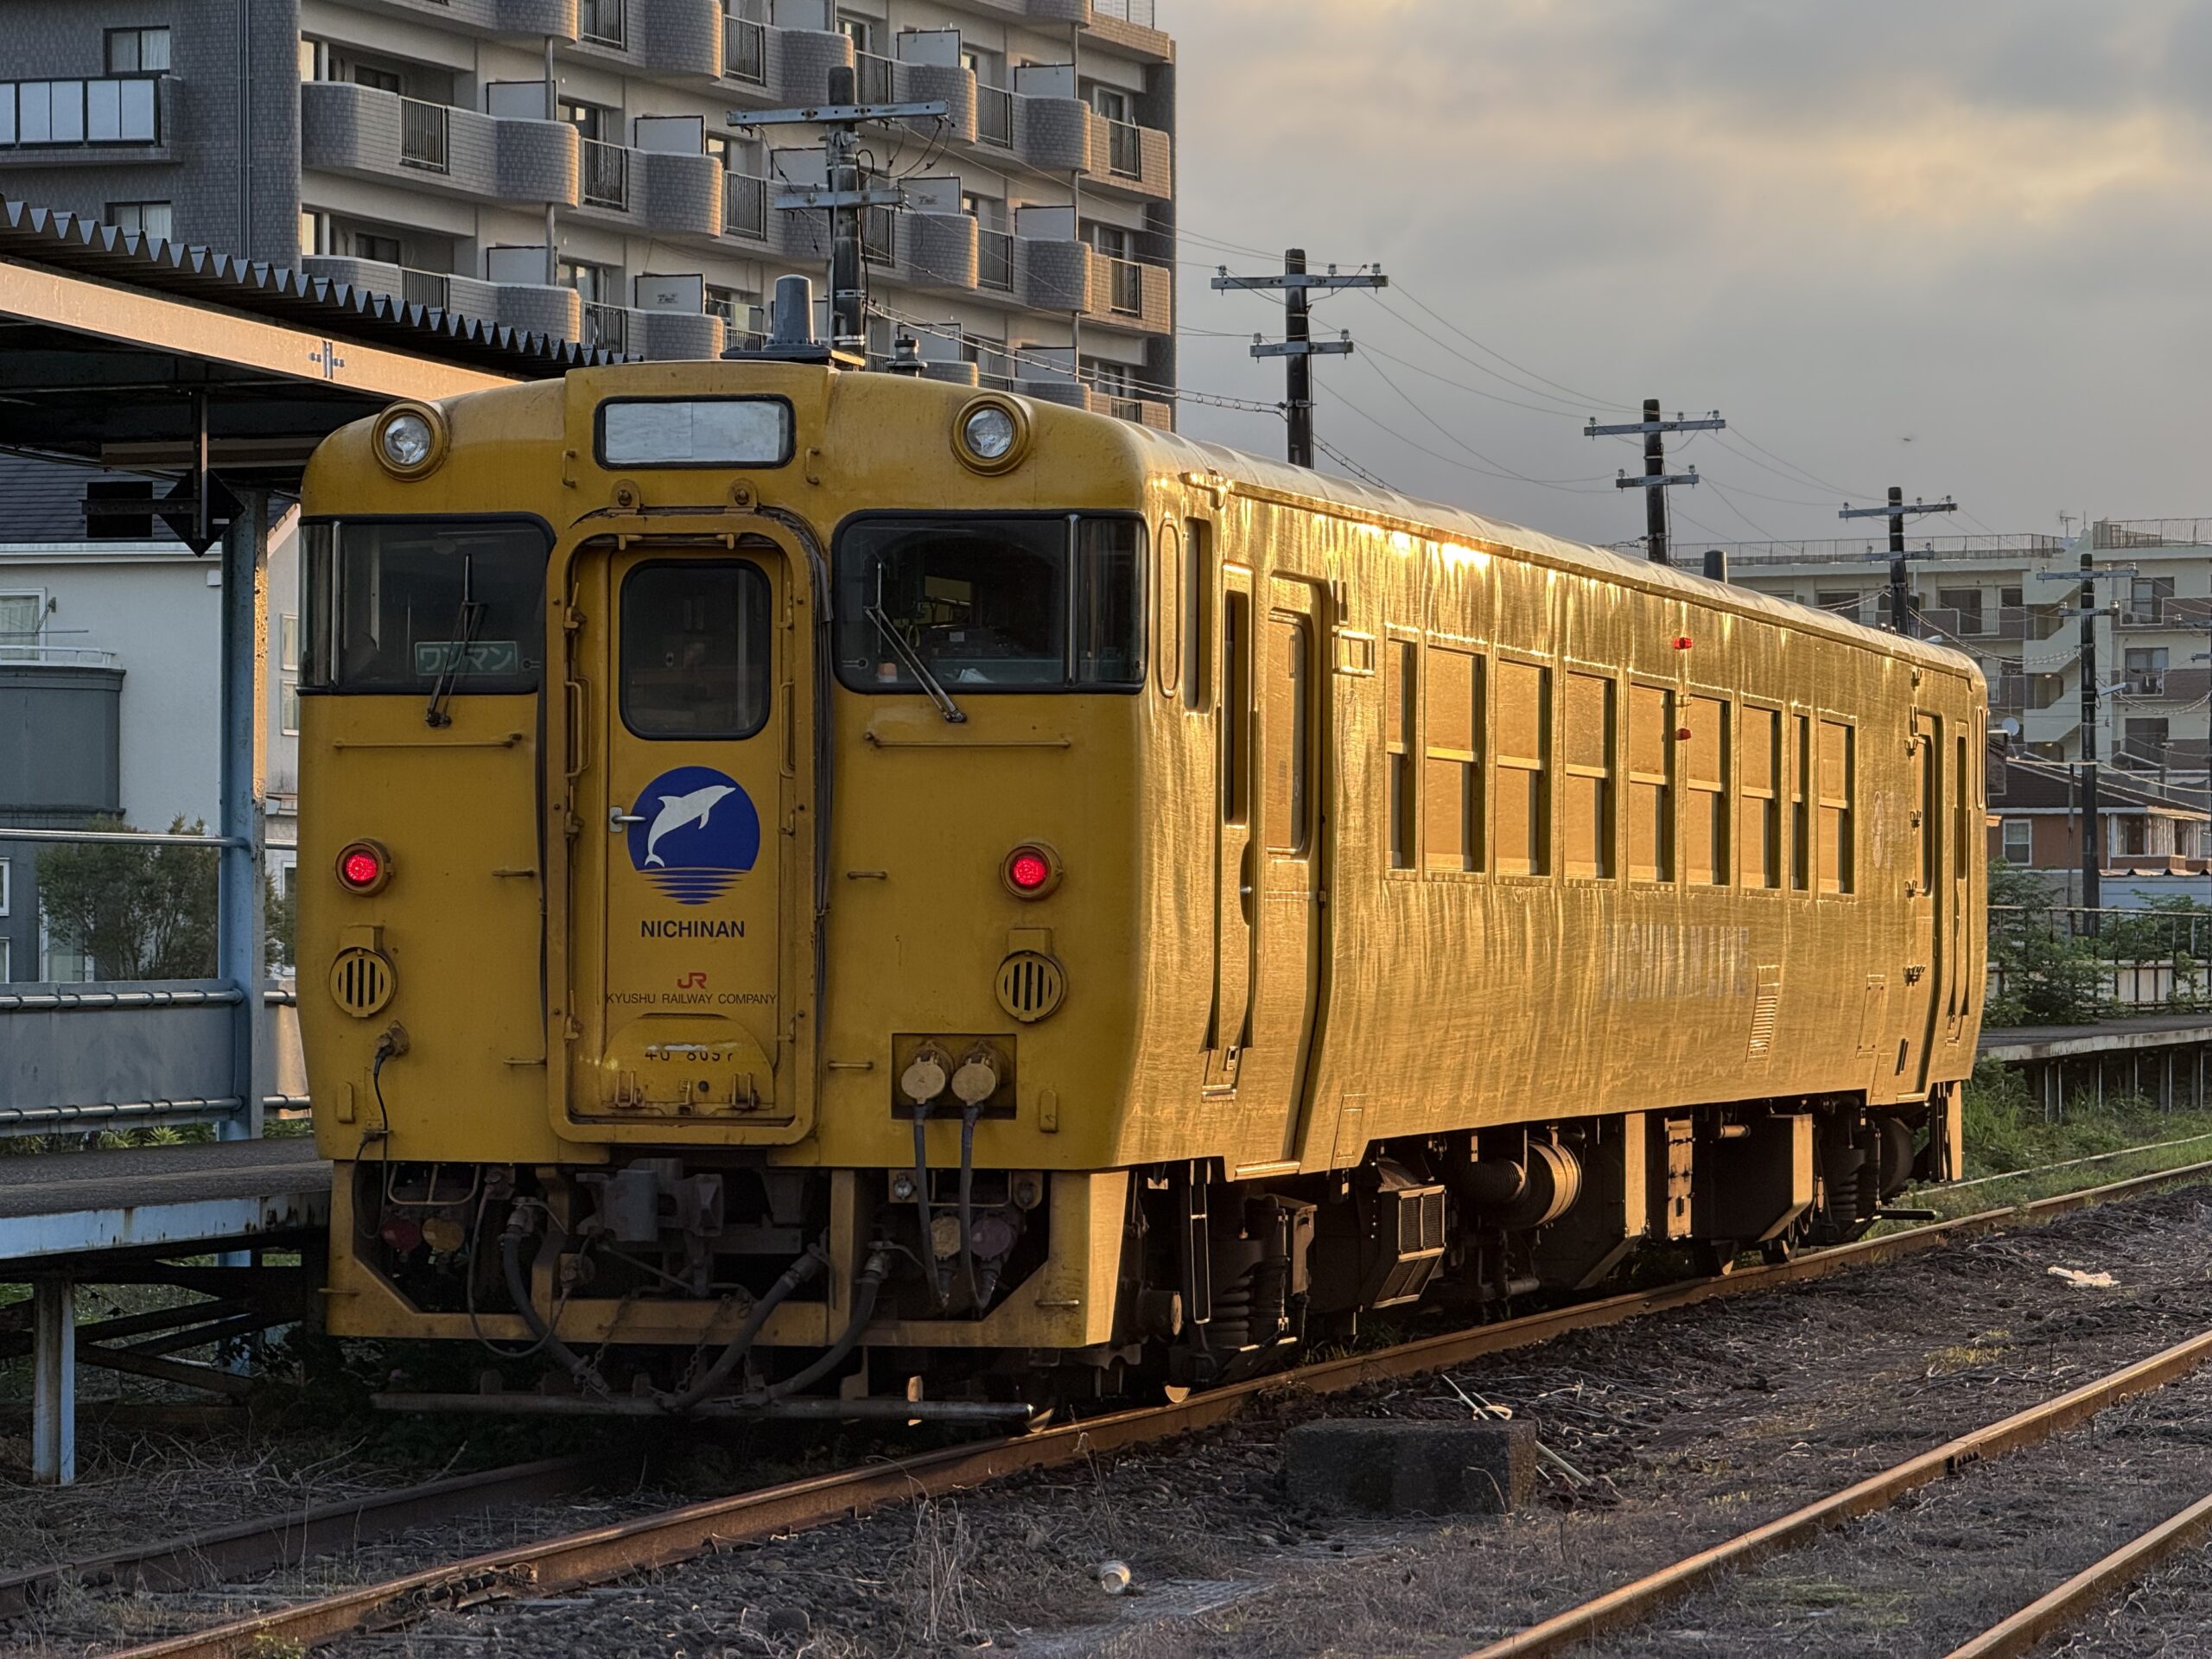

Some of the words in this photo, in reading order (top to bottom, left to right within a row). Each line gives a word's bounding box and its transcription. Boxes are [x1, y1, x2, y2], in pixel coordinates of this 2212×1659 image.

[419, 646, 512, 671] ワンマン
[641, 920, 745, 938] NICHINAN
[677, 972, 707, 988] JR
[607, 994, 656, 1004] KYUSHU
[662, 994, 713, 1004] RAILWAY
[718, 994, 778, 1004] COMPANY
